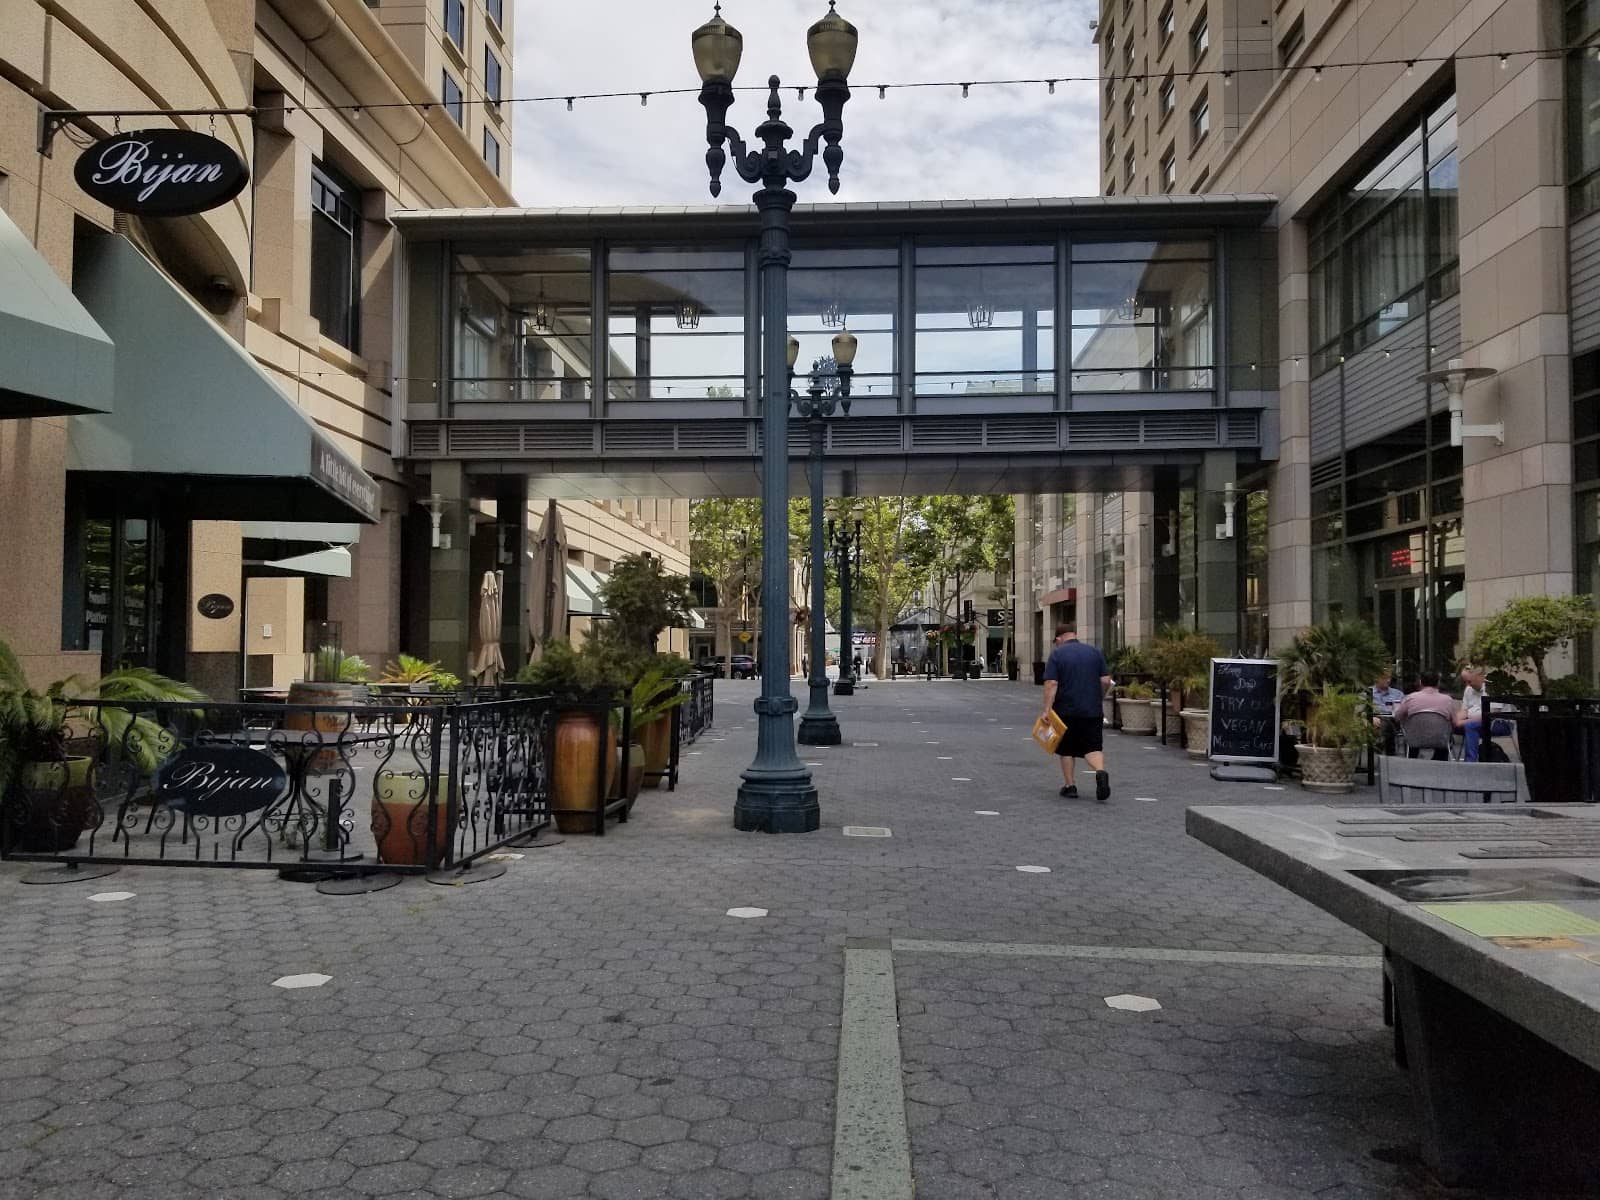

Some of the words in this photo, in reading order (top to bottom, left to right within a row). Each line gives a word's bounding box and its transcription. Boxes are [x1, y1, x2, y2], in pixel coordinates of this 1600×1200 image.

[91, 140, 223, 202] Bijan
[325, 453, 339, 482] little
[162, 760, 274, 801] Bijan
